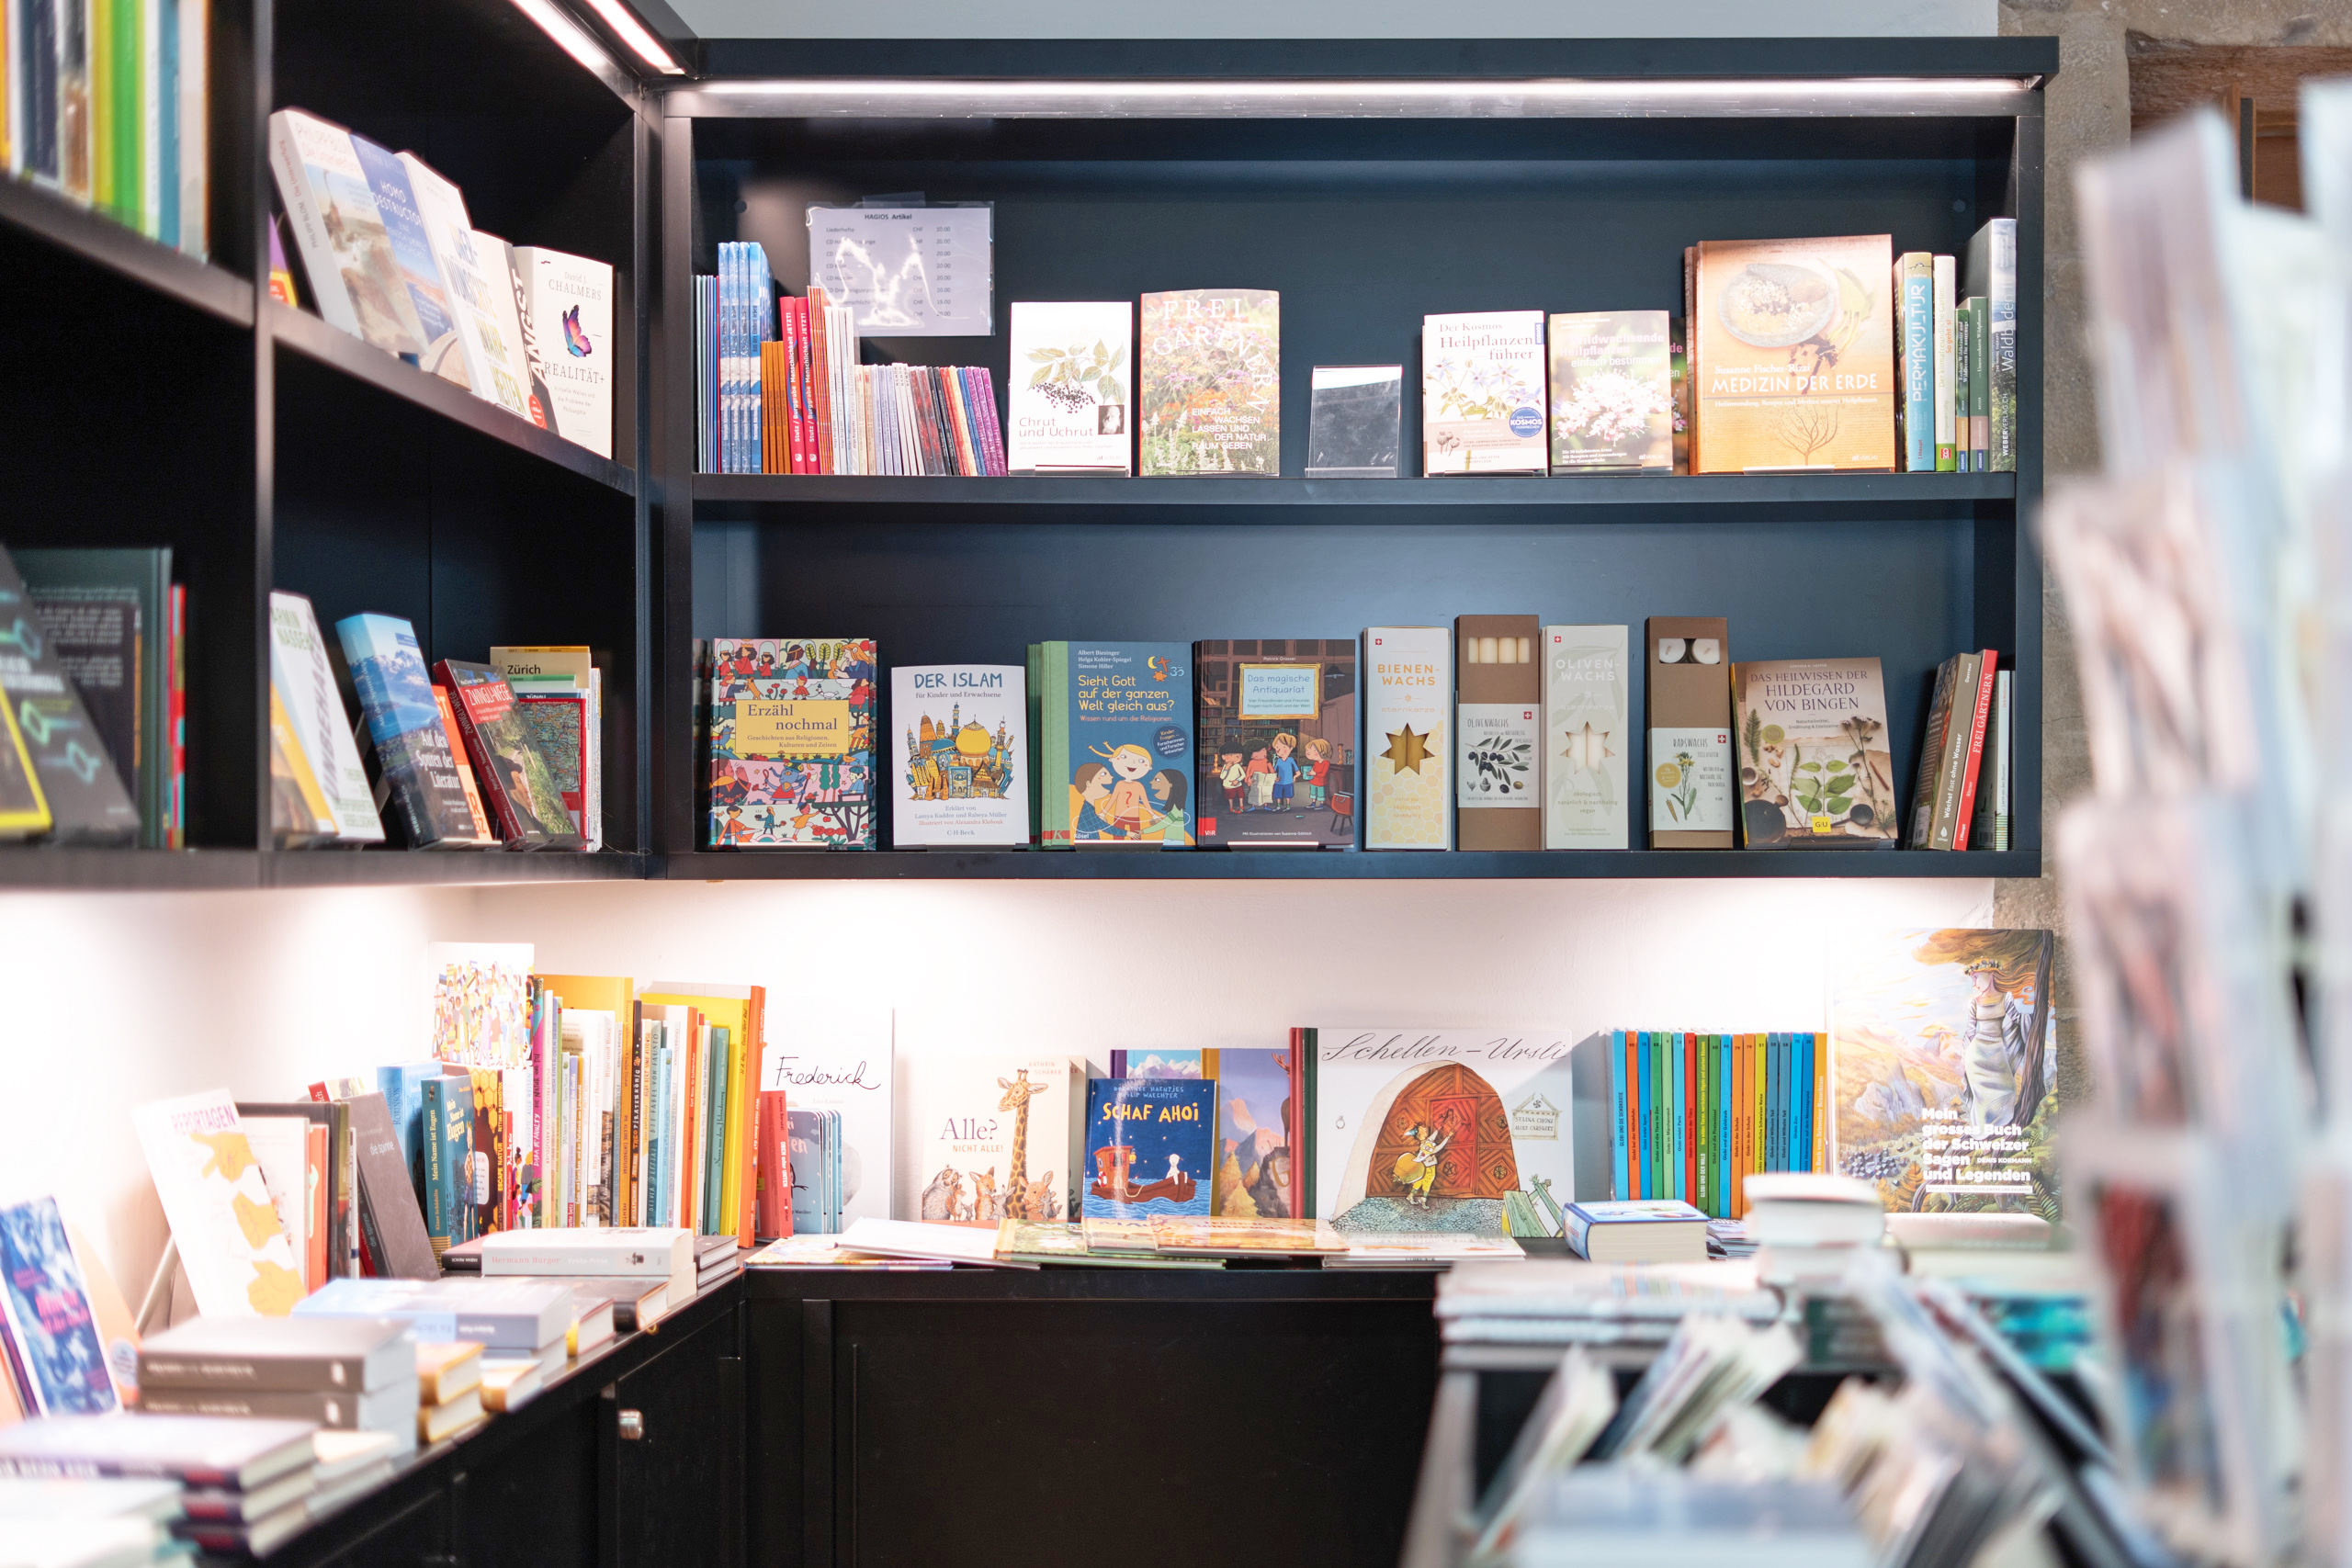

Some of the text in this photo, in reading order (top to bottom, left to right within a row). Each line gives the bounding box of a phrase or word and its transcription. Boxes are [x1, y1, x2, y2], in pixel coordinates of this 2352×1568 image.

[380, 180, 406, 203] HOMO
[371, 191, 424, 228] DESTRUCTOR
[564, 271, 588, 285] David J.
[548, 279, 602, 301] CHALMERS
[1162, 299, 1242, 321] FREI
[1440, 323, 1502, 333] Der Kosmos
[1441, 334, 1533, 351] Heilpflanzen
[1571, 333, 1665, 345] Wildwachsende
[1911, 285, 1927, 401] PERMAKULTUR
[1489, 348, 1534, 360] führer
[1560, 345, 1631, 357] Heilpflanzen
[787, 335, 796, 382] Menschlichkeit
[1571, 355, 1662, 367] einfach bestimmen
[544, 361, 605, 384] REALITÄT+
[1152, 325, 1273, 414] GÄRTNERN
[1714, 363, 1810, 374] Susanne Fischer-Rizzi
[1712, 373, 1877, 393] MEDIZIN DER ERDE
[1192, 408, 1231, 416] EINFACH
[1019, 417, 1057, 427] Chrut
[1215, 416, 1261, 424] WACHSEN
[1019, 427, 1094, 437] und Uchrut
[1192, 442, 1218, 450] RAUM
[507, 664, 541, 675] Zürich
[1377, 664, 1440, 673] BIENEN-
[1555, 659, 1620, 670] OLIVEN-
[914, 672, 1002, 689] DER ISLAM
[1078, 675, 1136, 686] Sieht Gott
[1248, 674, 1310, 684] Das magische
[1382, 676, 1436, 686] WACHS
[1561, 671, 1616, 682] WACHS
[1750, 671, 1868, 682] DAS HEILWISSEN DER
[465, 683, 514, 705] ZWINGLI-WEGE
[1078, 687, 1170, 701] auf der ganzen
[1252, 685, 1305, 695] Antiquariat
[1766, 682, 1855, 697] HILDEGARD
[748, 704, 794, 716] Erzähl
[1079, 699, 1174, 714] Welt gleich aus?
[1764, 697, 1859, 711] VON BINGEN
[1973, 673, 1993, 753] FREI GÄRTNERN
[775, 717, 838, 730] nochmal
[1467, 717, 1510, 728] OLIVENWACHS
[421, 729, 448, 748] Auf den
[416, 752, 454, 771] Spuren der
[430, 772, 460, 789] Literatur
[1943, 792, 1952, 818] Wächst
[1952, 733, 1962, 760] Wasser
[1321, 1032, 1463, 1061] Schellen
[1486, 1037, 1567, 1060] Ursli
[605, 1063, 613, 1077] Rigo
[776, 1055, 881, 1090] Frederick
[446, 1099, 457, 1111] Mein
[1102, 1102, 1153, 1121] SCHAF
[171, 1104, 237, 1135] REPORTAGEN
[1922, 1107, 1958, 1120] Mein
[447, 1120, 465, 1143] Eugen
[939, 1117, 998, 1140] Alle?
[1922, 1123, 2022, 1137] grosses Buch
[953, 1145, 1003, 1153] NICHT ALLE!
[1922, 1137, 2030, 1151] der Schweizer
[1923, 1153, 1971, 1168] Sagen
[1923, 1168, 2030, 1183] und Legenden
[492, 1256, 529, 1264] Hermann
[532, 1257, 560, 1265] Burger
